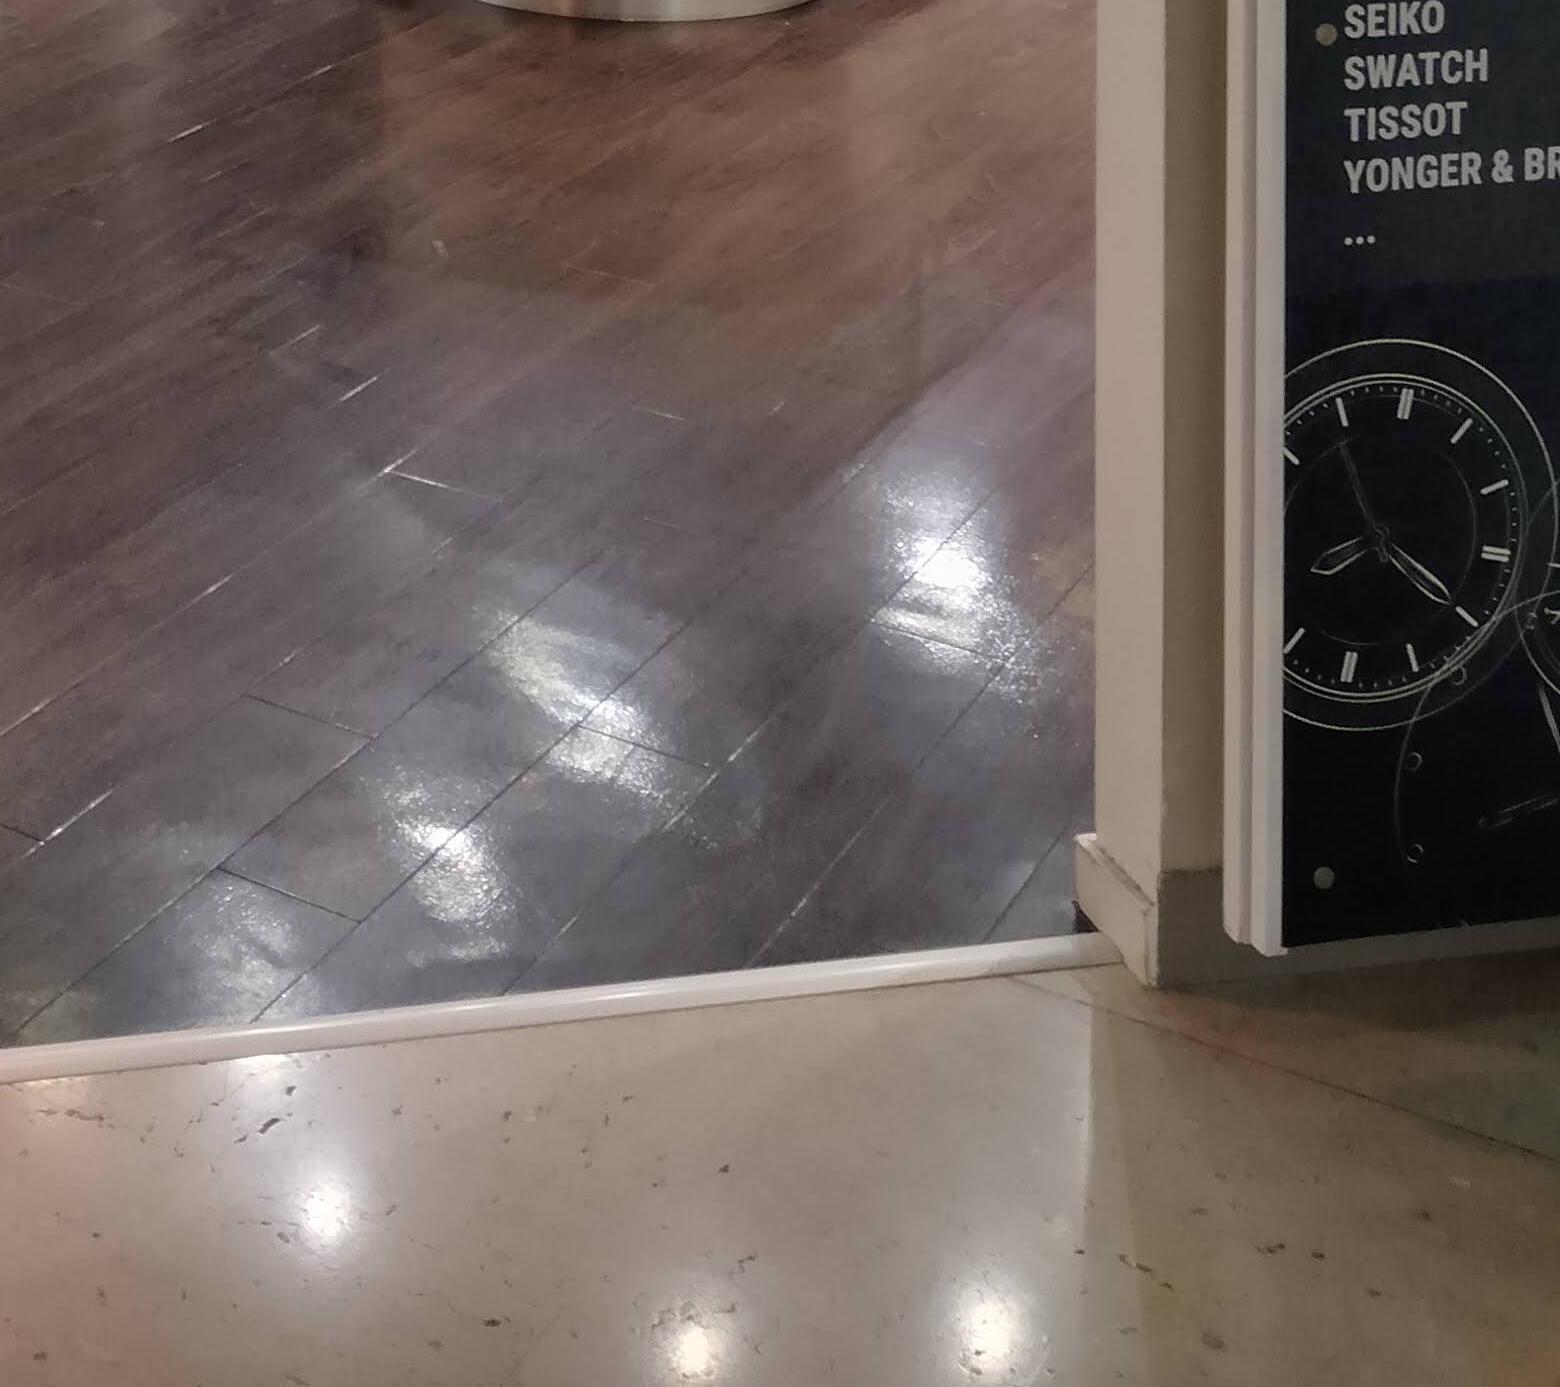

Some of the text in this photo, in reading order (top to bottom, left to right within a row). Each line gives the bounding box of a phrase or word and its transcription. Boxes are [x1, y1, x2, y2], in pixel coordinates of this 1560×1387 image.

[1343, 0, 1445, 39] SEIKO
[1343, 48, 1489, 91] SWATCH
[1343, 100, 1468, 143] TISSOT
[1343, 151, 1483, 195] YONGER
[1491, 149, 1515, 184] &
